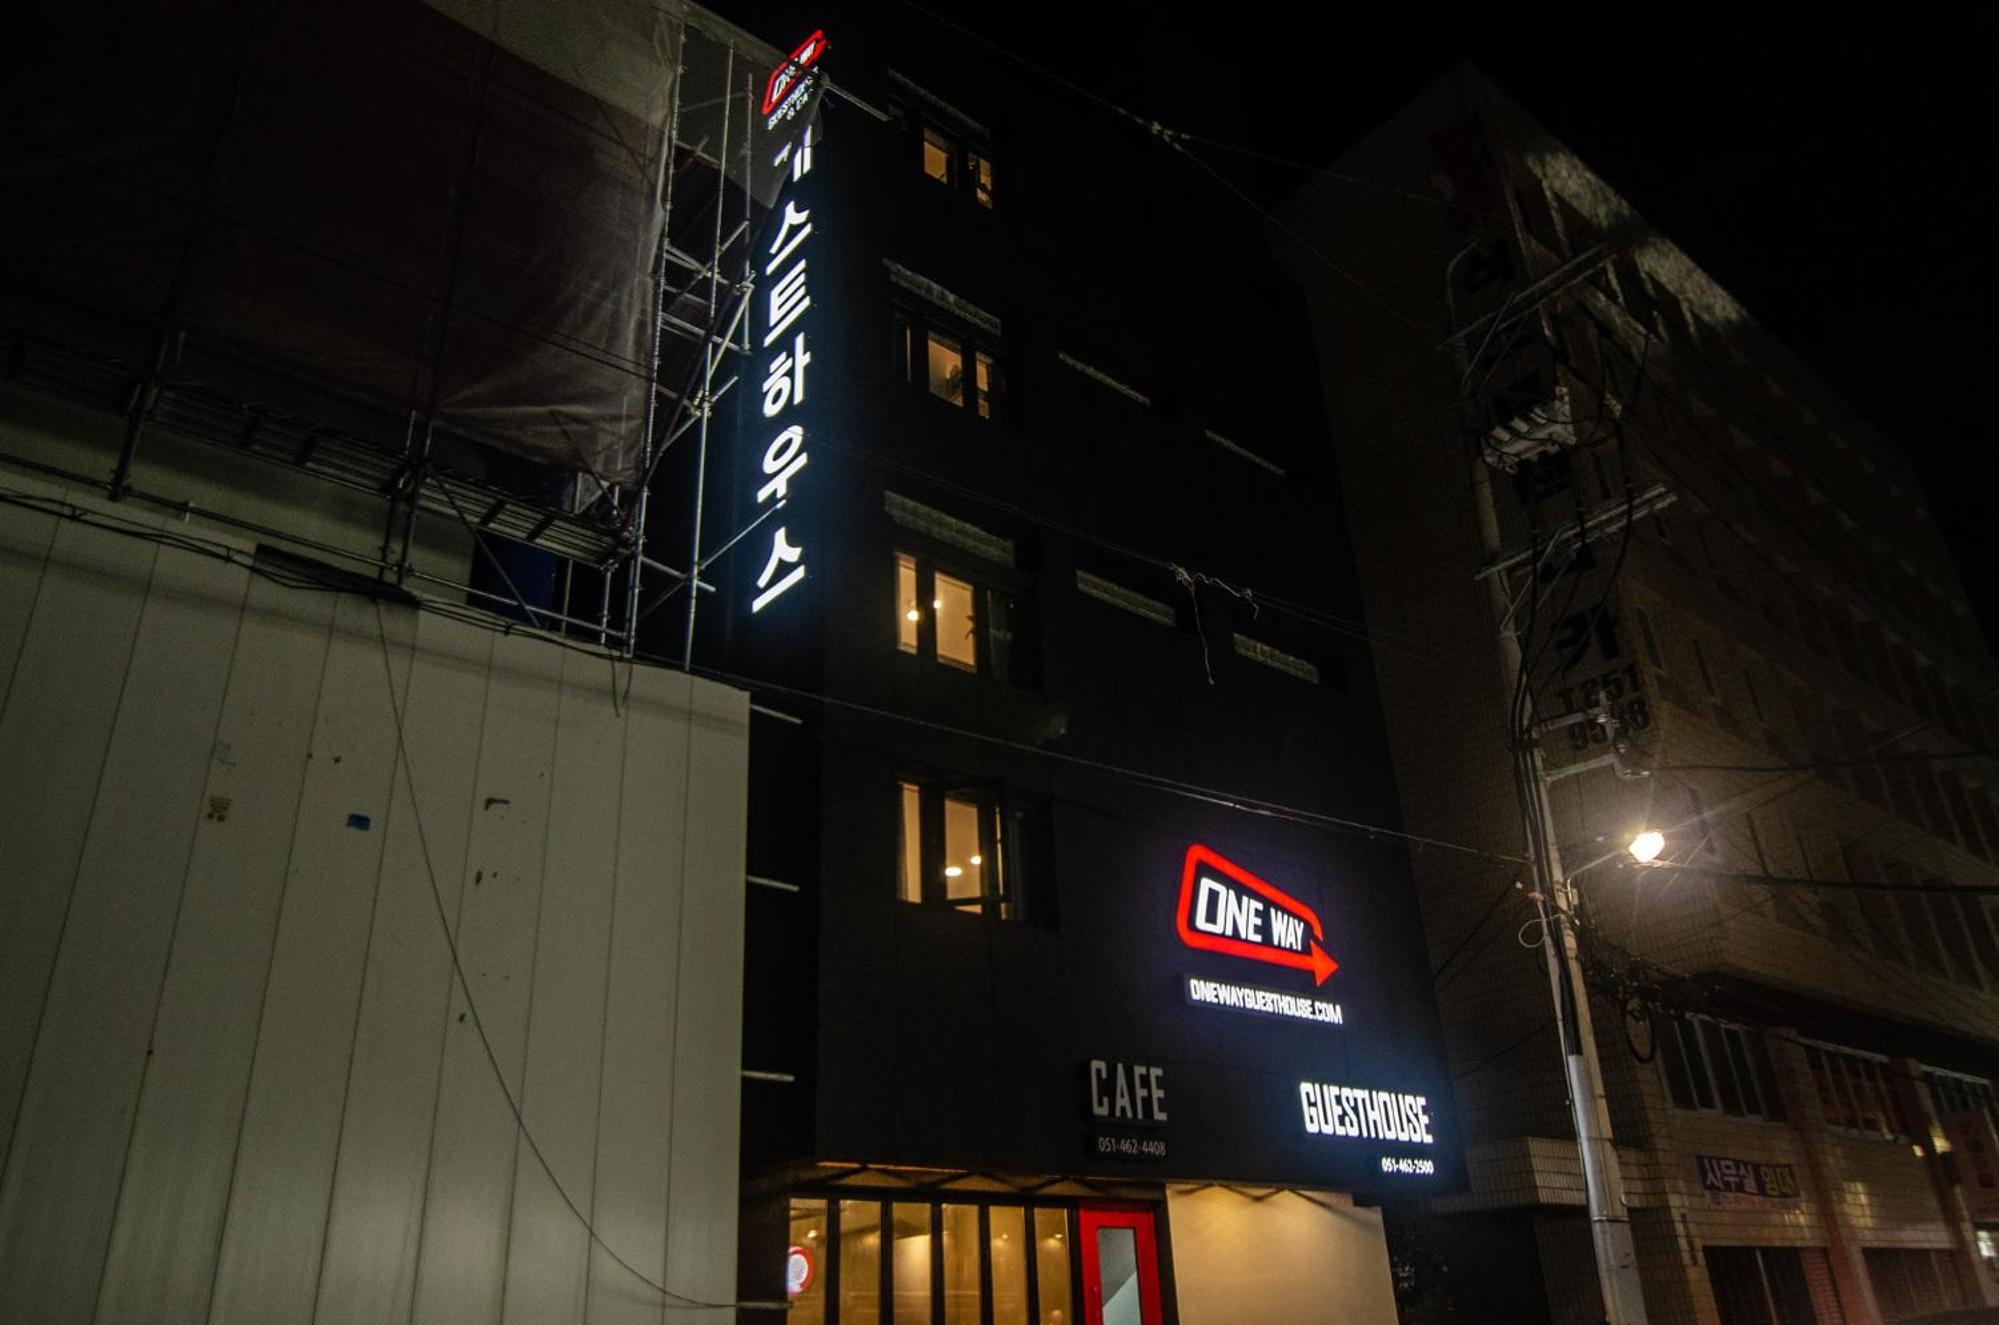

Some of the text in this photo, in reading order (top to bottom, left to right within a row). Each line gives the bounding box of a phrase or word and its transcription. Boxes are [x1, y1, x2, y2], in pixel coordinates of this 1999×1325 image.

[752, 124, 813, 614] 게스트하우스
[1195, 877, 1305, 951] ONE WAY
[1189, 978, 1343, 1025] ONEWAYGUESTHOUSE.COM
[1090, 1059, 1168, 1121] CAFE
[1299, 1081, 1434, 1144] GUESTHOUSE
[1381, 1156, 1435, 1175] 051-462-2500
[1703, 1157, 1760, 1196] 사무실
